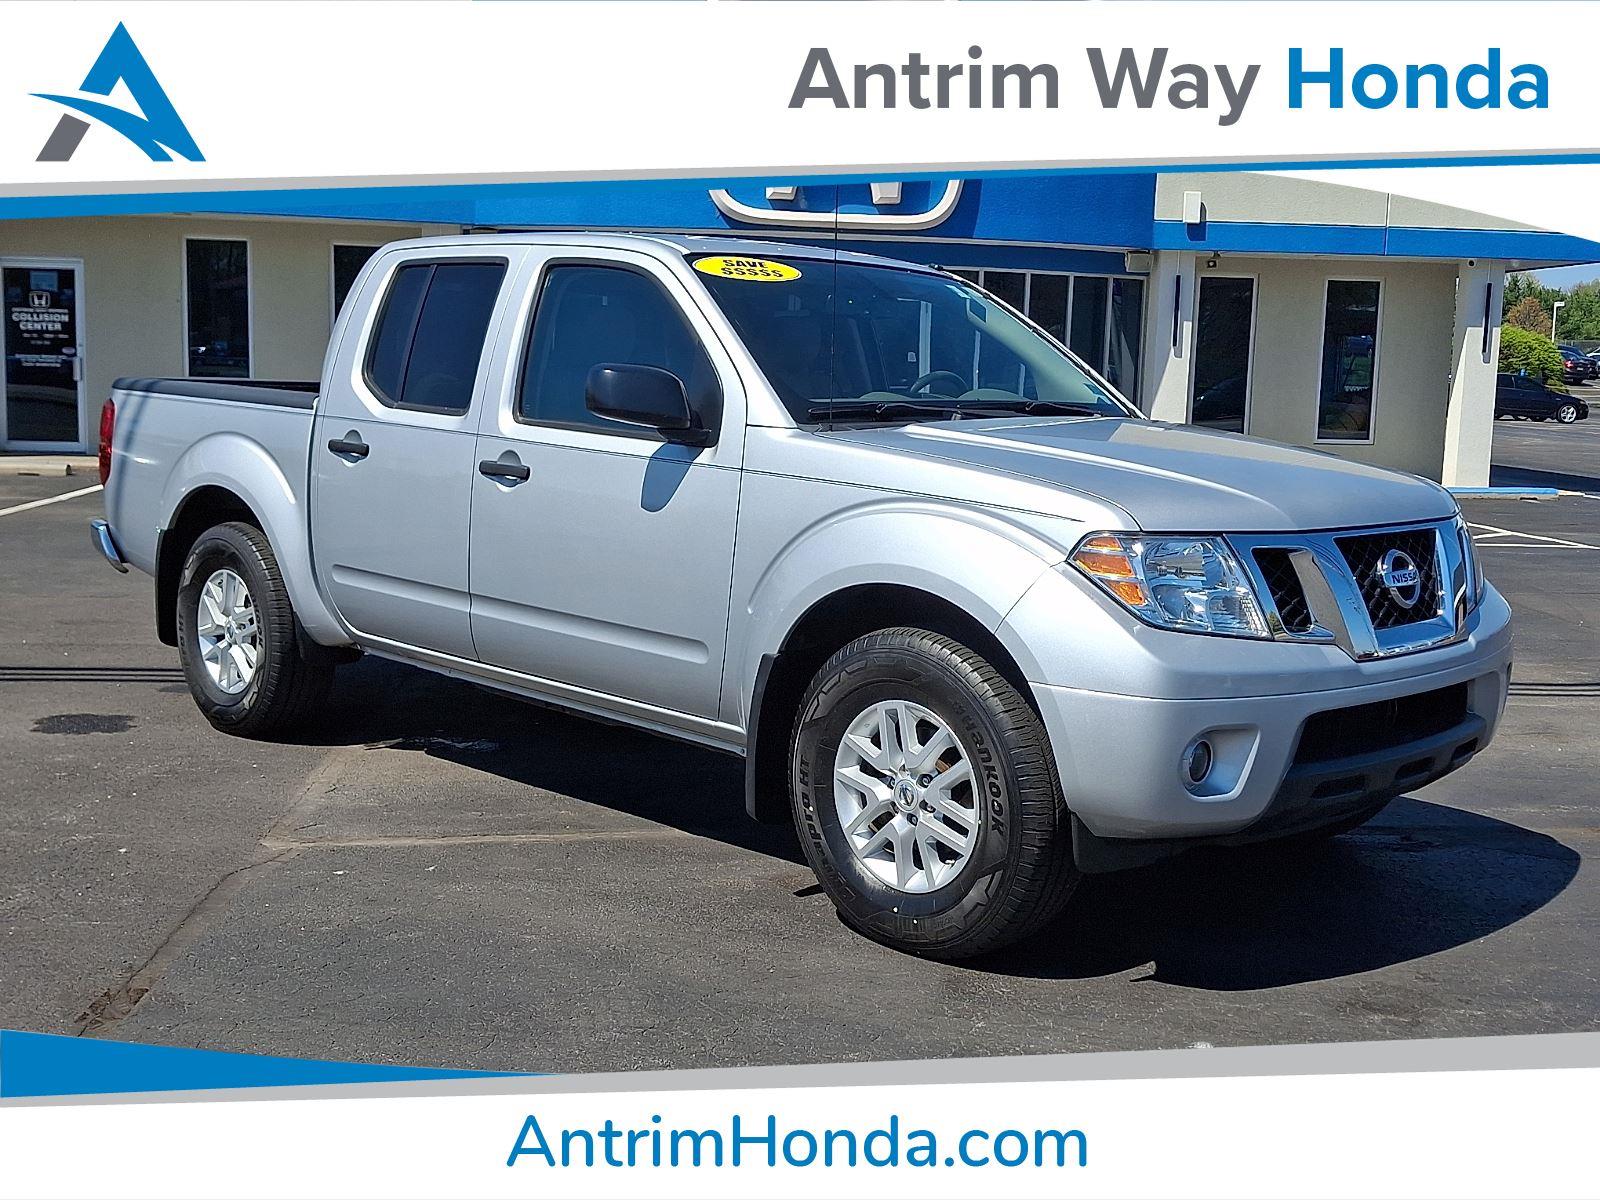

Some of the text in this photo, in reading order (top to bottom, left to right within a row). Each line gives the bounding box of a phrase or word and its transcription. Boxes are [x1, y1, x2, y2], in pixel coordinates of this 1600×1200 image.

[722, 259, 769, 269] SAVE
[11, 312, 69, 322] COLLISION
[19, 322, 62, 331] CENTER
[1391, 569, 1418, 585] NISSA
